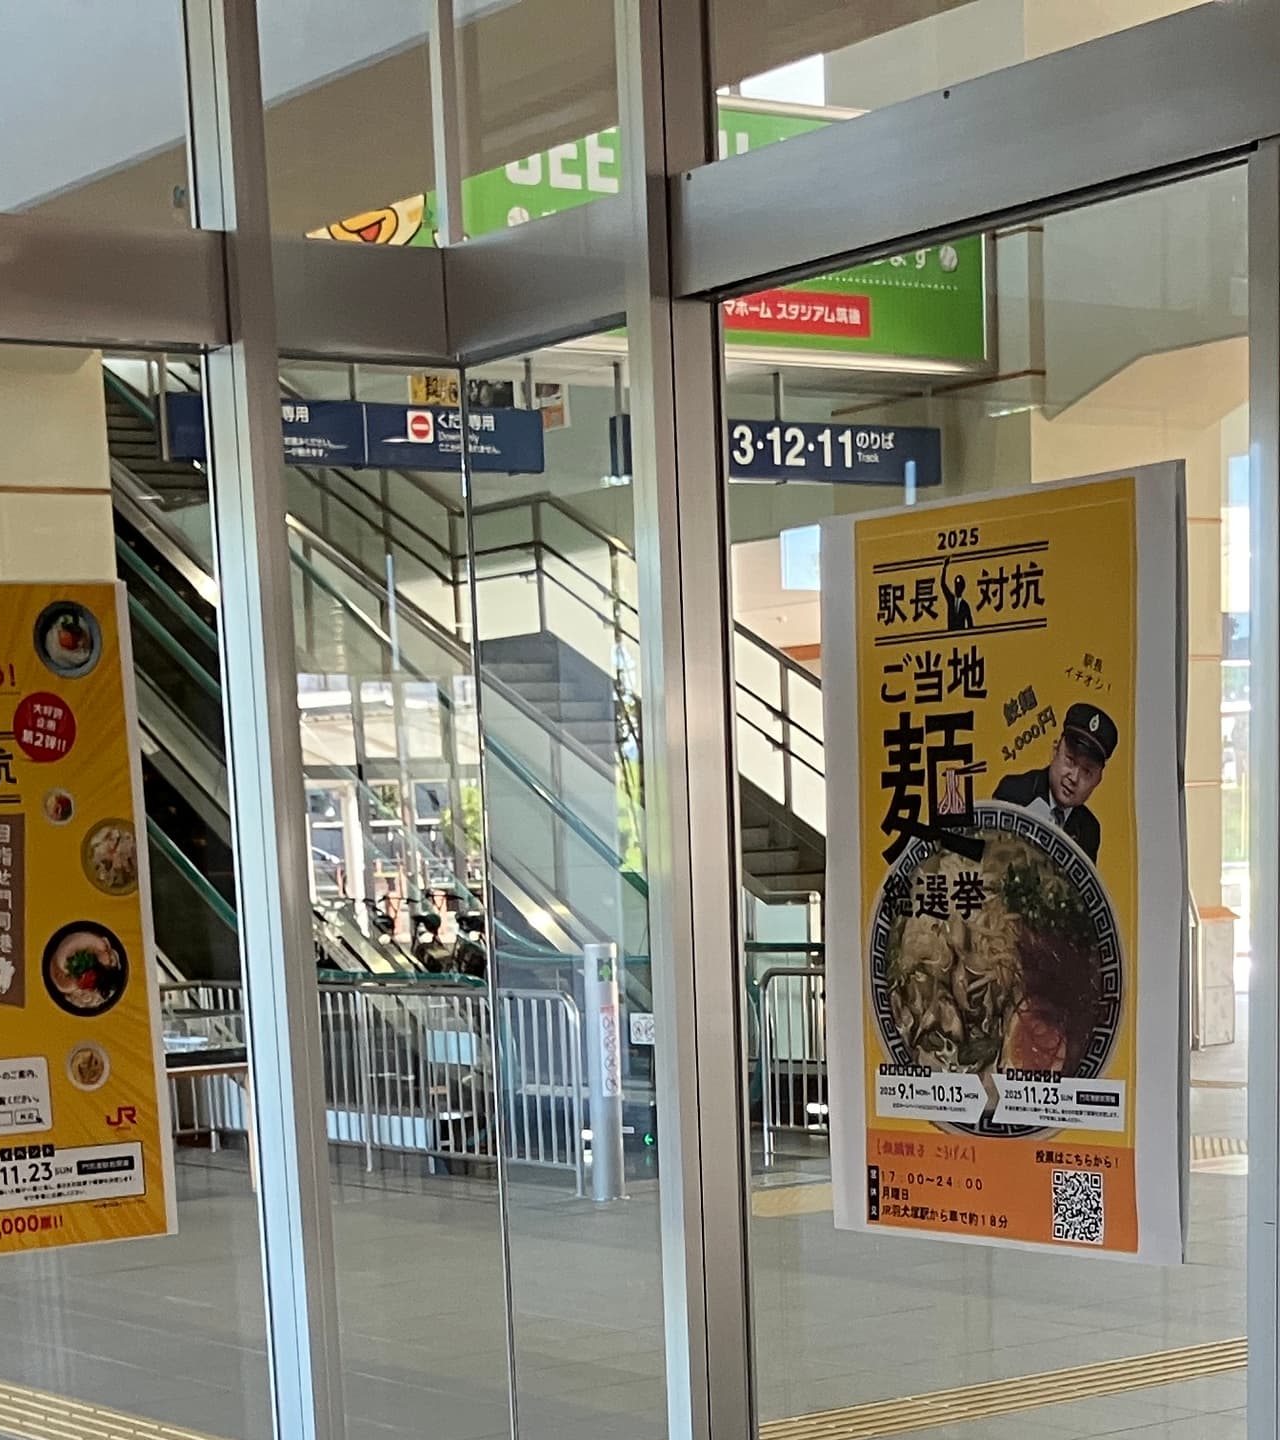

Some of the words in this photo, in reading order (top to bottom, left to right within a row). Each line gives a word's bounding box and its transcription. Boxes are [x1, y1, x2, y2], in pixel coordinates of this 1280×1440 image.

[856, 431, 896, 450] のりば
[937, 528, 980, 550] 2025
[881, 645, 988, 705] ご当地
[880, 711, 987, 866] 麺
[883, 871, 987, 921] 総選挙
[897, 1082, 915, 1101] 9.1
[931, 1084, 963, 1104] 10.13
[1004, 1089, 1023, 1100] 2025
[1023, 1085, 1060, 1106] 11.23
[106, 1106, 138, 1126] JR
[0, 1161, 53, 1187] 11.23
[881, 1185, 910, 1201] 月曜日
